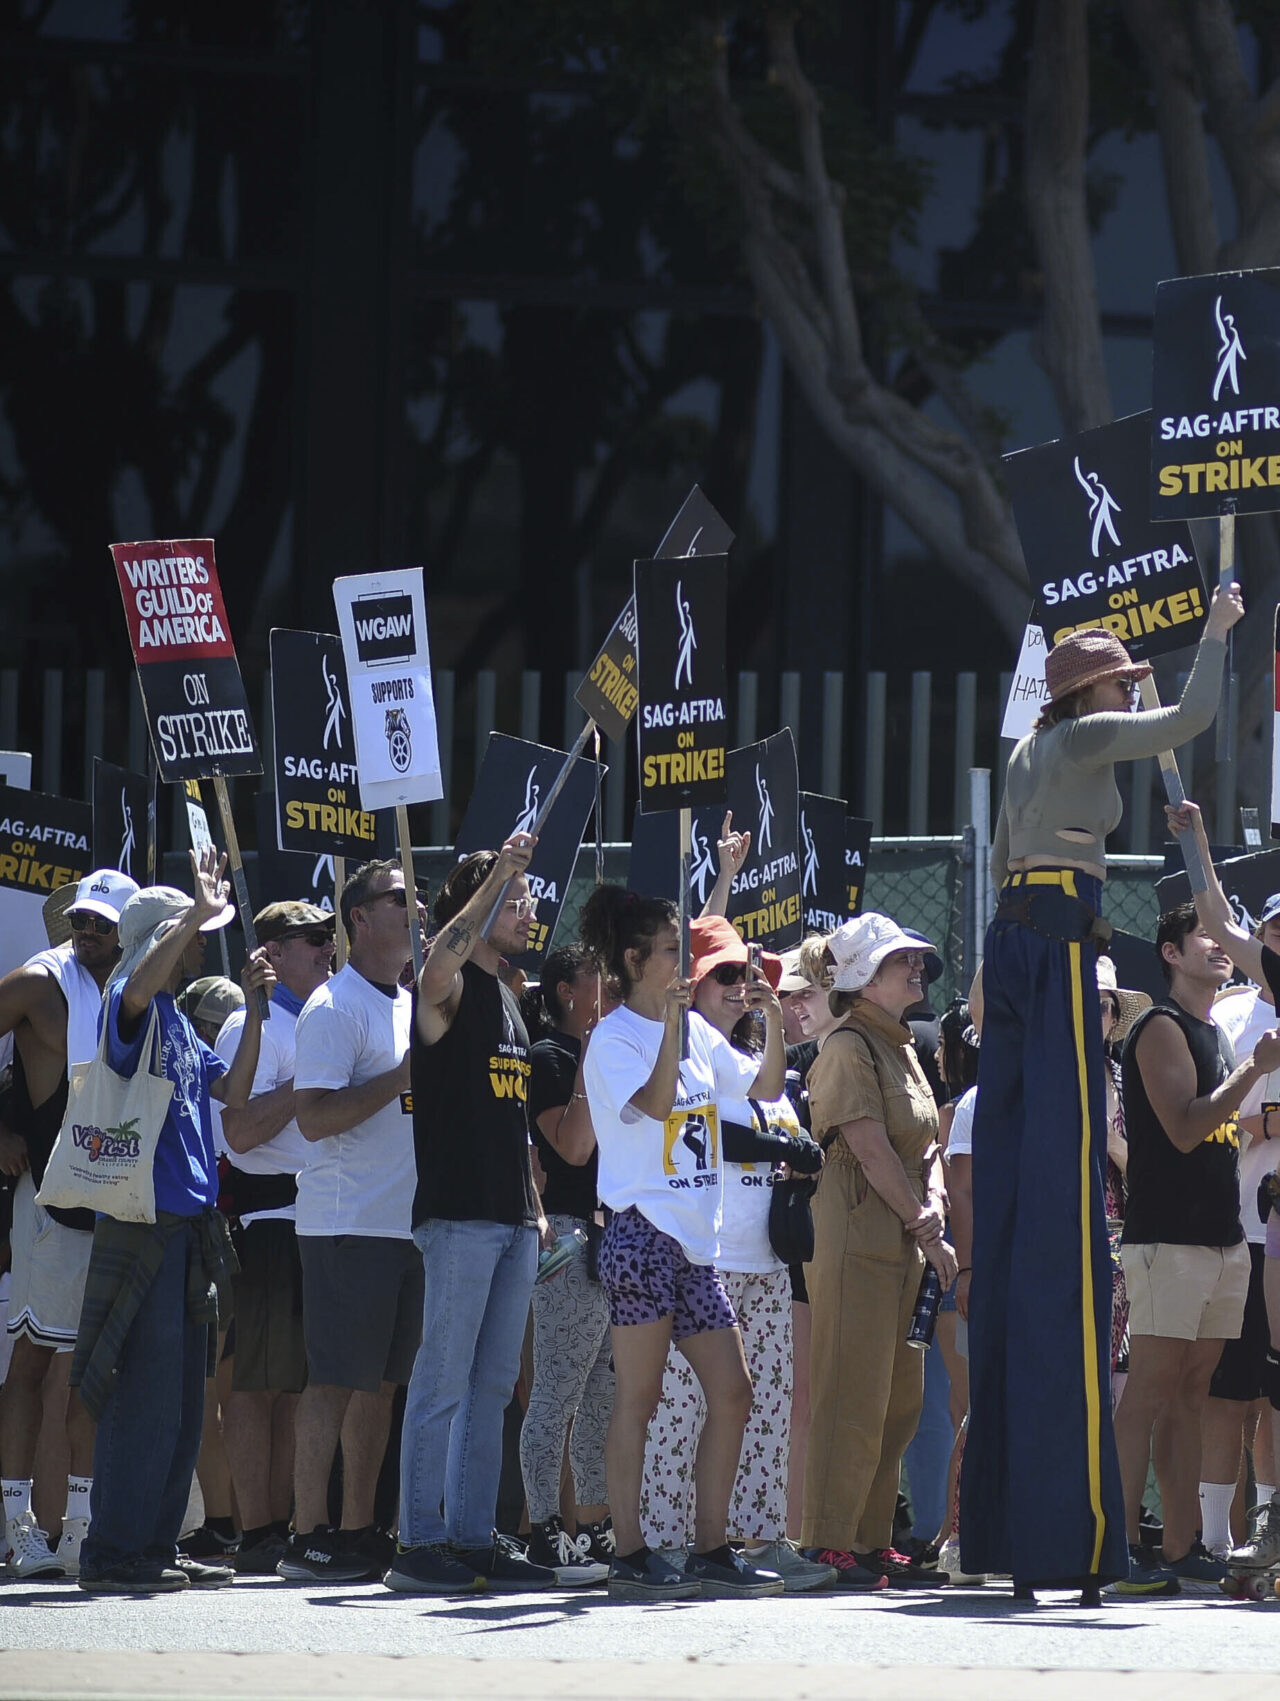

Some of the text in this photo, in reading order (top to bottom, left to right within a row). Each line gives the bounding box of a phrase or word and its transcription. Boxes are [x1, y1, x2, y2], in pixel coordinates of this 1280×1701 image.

[1215, 440, 1243, 458] ON
[123, 556, 209, 588] WRITERS
[135, 587, 214, 619] GUILD OF
[1108, 587, 1139, 610] ON
[138, 615, 226, 648] AMERICA
[355, 614, 412, 642] WGAW
[622, 653, 636, 674] ON
[183, 673, 208, 706] ON
[371, 677, 415, 704] SUPPORTS
[589, 653, 638, 721] STRIKE!
[643, 698, 725, 729] SAG·AFTRA
[157, 709, 254, 762] STRIKE
[677, 731, 694, 749] ON
[283, 756, 358, 786] SAG·AFT
[643, 747, 725, 787] STRIKE!
[327, 787, 347, 804] ON
[0, 817, 88, 851] AG·AFTRA
[285, 800, 376, 841] STRIKE!
[11, 840, 36, 857] ON
[0, 854, 83, 890] RIKE!
[90, 880, 110, 895] alo
[761, 886, 776, 905] ON
[668, 1177, 691, 1189] ON
[741, 1174, 763, 1188] ON
[304, 1549, 333, 1564] HOKA
